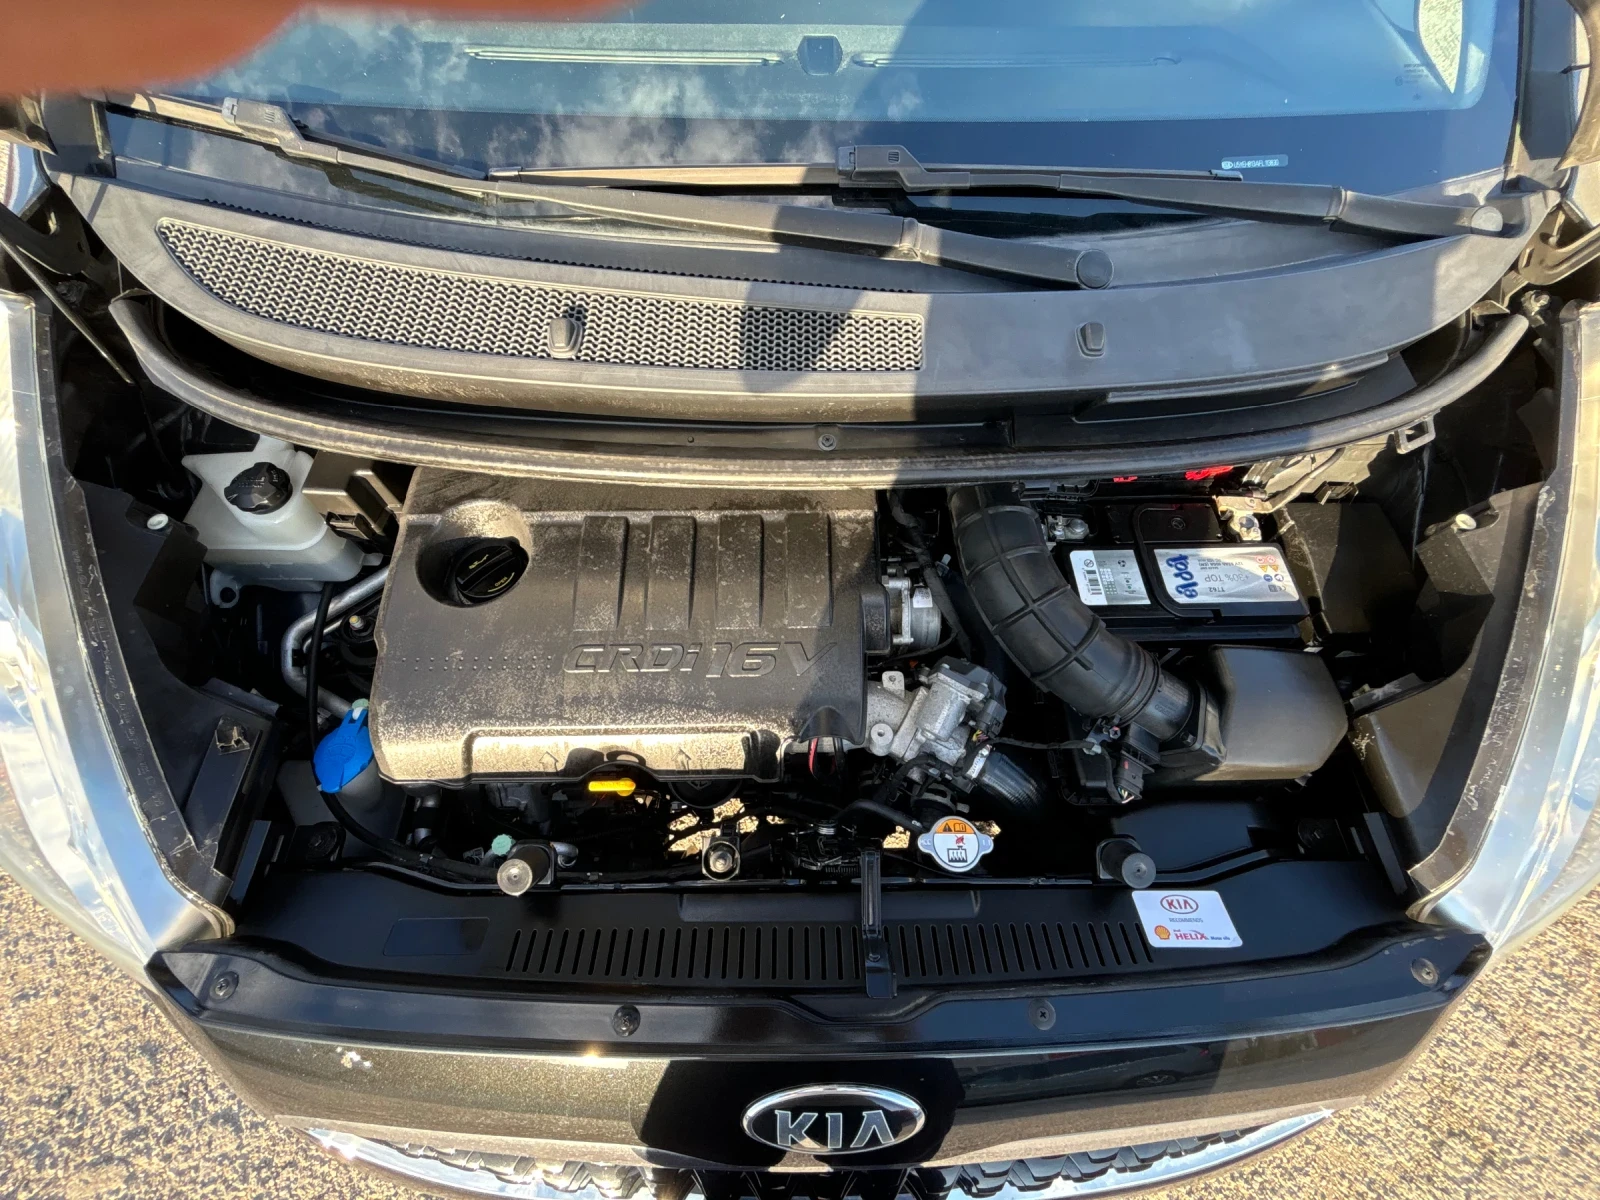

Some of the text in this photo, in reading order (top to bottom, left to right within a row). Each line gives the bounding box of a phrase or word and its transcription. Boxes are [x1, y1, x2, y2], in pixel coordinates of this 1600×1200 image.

[494, 576, 508, 587] OPEN
[1204, 574, 1225, 583] TOP
[705, 641, 838, 678] 16V
[1165, 898, 1194, 910] KIA
[1174, 933, 1208, 941] HELIX
[775, 1109, 895, 1149] KIA
